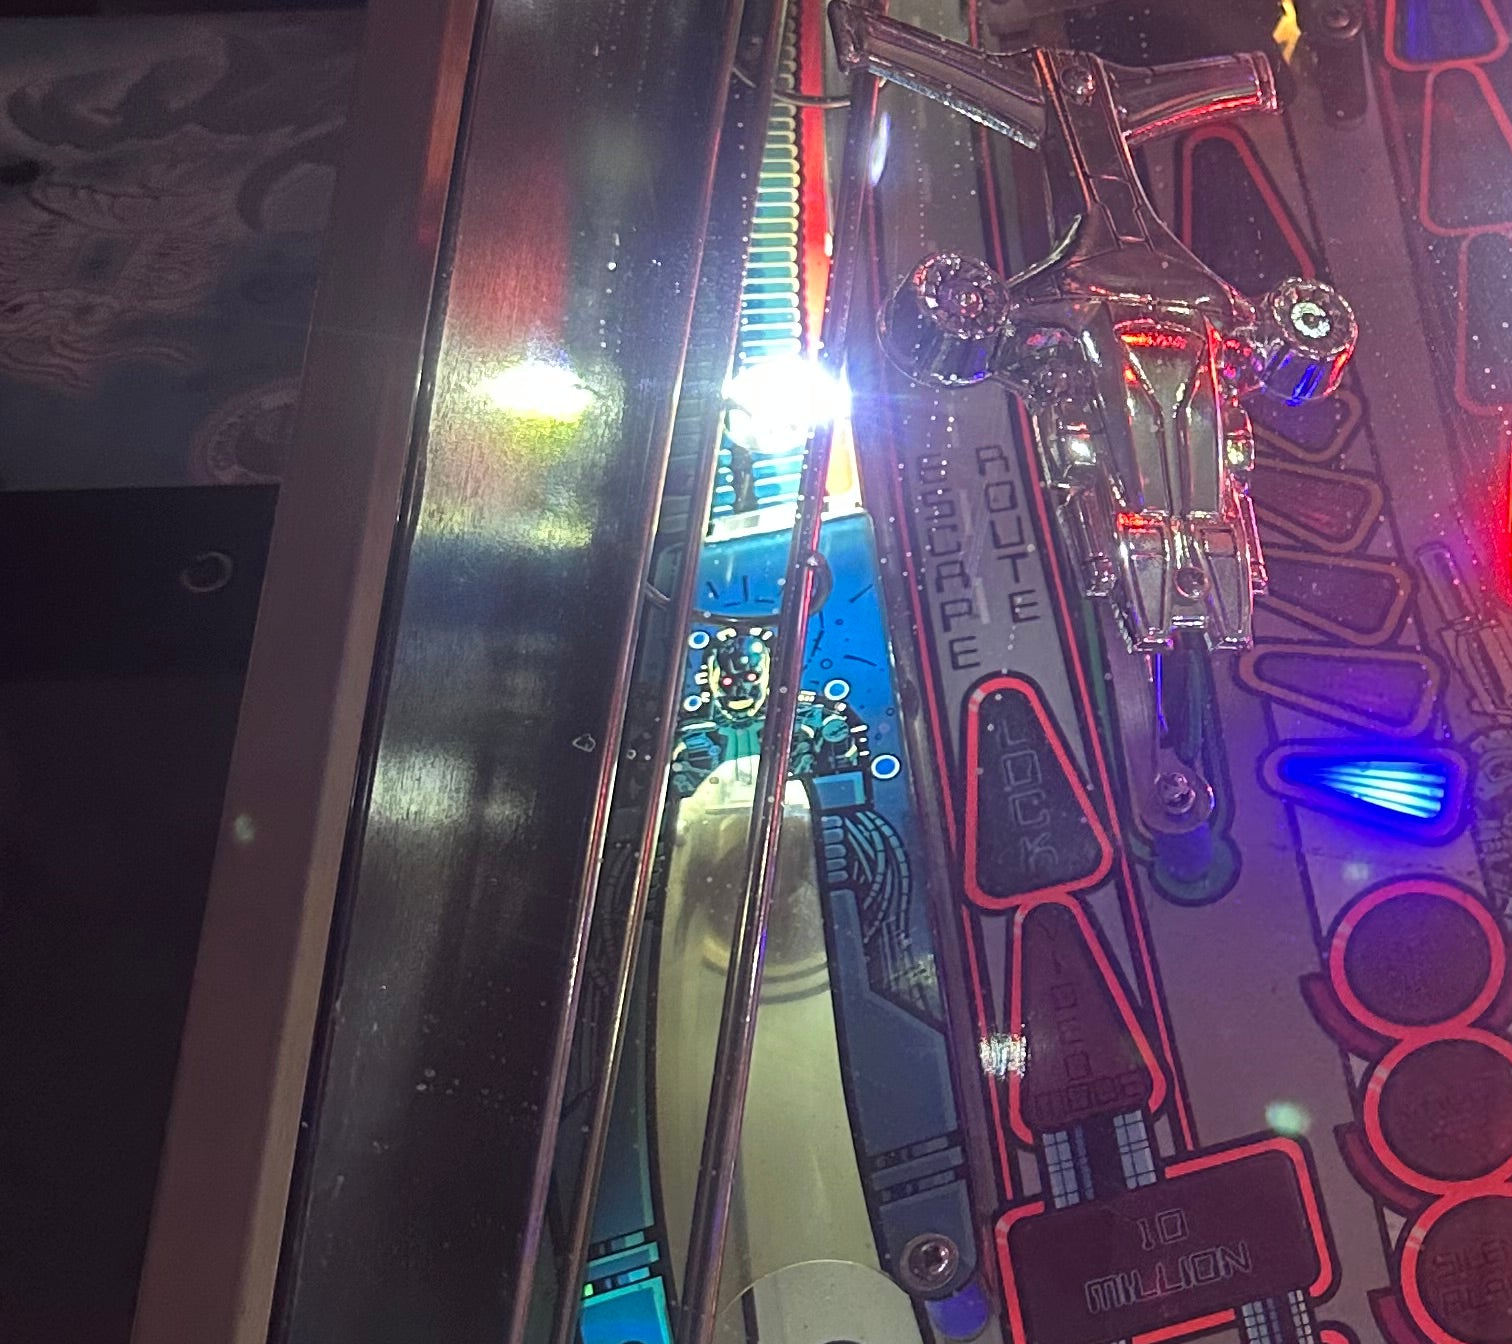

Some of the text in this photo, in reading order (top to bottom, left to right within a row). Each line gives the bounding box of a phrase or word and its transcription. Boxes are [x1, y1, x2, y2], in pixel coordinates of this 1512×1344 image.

[915, 452, 980, 671] ESCAPE
[976, 444, 1043, 623] ROUTE
[995, 720, 1058, 873] LOCK
[1040, 920, 1094, 1083] VIDEO
[1033, 1067, 1149, 1122] MODE
[1083, 1238, 1255, 1315] MILLION
[1135, 1206, 1190, 1252] 10
